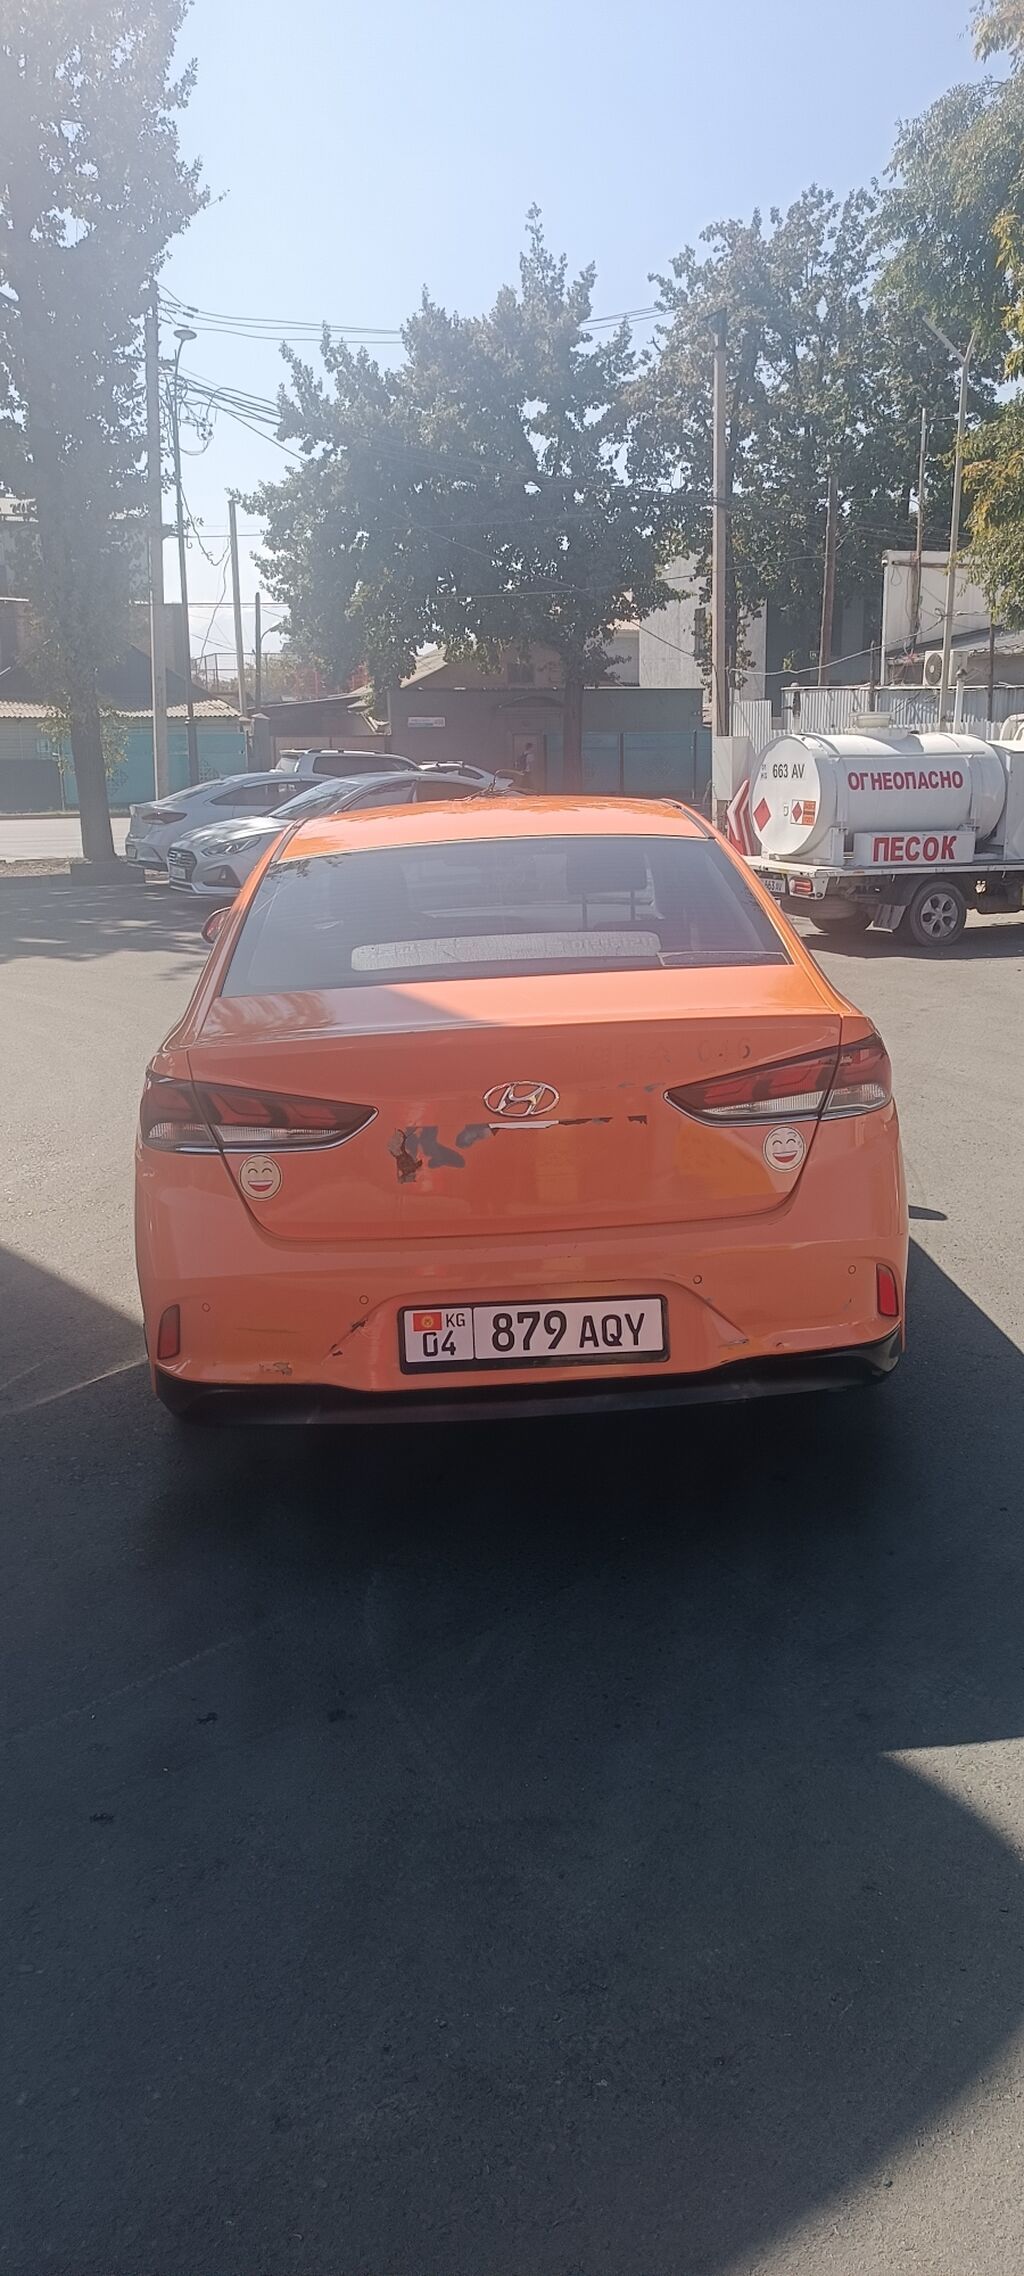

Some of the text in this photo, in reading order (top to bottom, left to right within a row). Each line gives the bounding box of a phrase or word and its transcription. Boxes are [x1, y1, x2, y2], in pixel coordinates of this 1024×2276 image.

[772, 763, 806, 778] 663 AV
[847, 770, 964, 791] ОГНЕОПАСНО
[872, 835, 957, 862] ПЕСОК
[446, 1312, 466, 1328] KG
[491, 1310, 645, 1352] 879 AQY
[422, 1330, 457, 1357] 04
